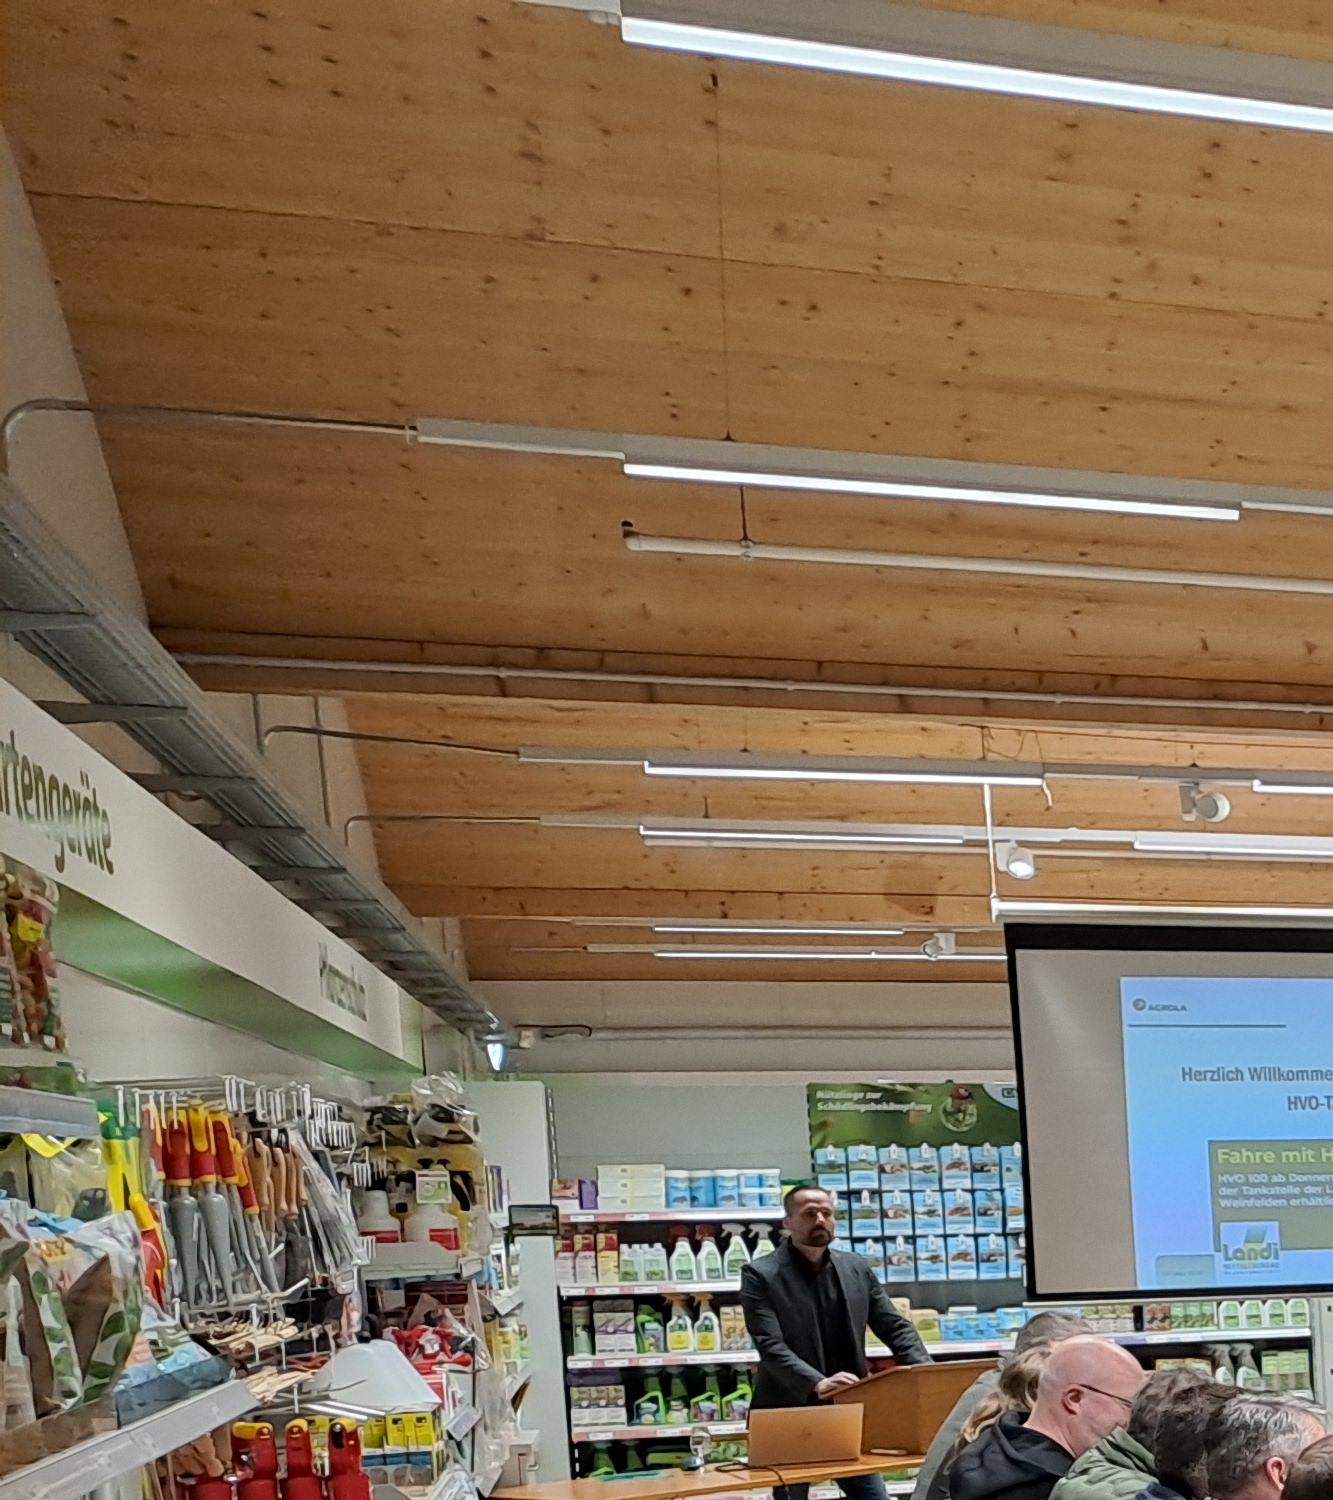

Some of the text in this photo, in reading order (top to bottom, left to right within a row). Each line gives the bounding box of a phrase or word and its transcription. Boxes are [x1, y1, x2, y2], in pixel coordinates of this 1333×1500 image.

[1181, 1066, 1244, 1082] Herzlich
[1217, 1147, 1276, 1164] Fahre
[1281, 1146, 1316, 1163] mit
[1217, 1174, 1245, 1183] HVO
[1241, 1185, 1301, 1195] Tankstelle
[1222, 1243, 1280, 1262] Landi
